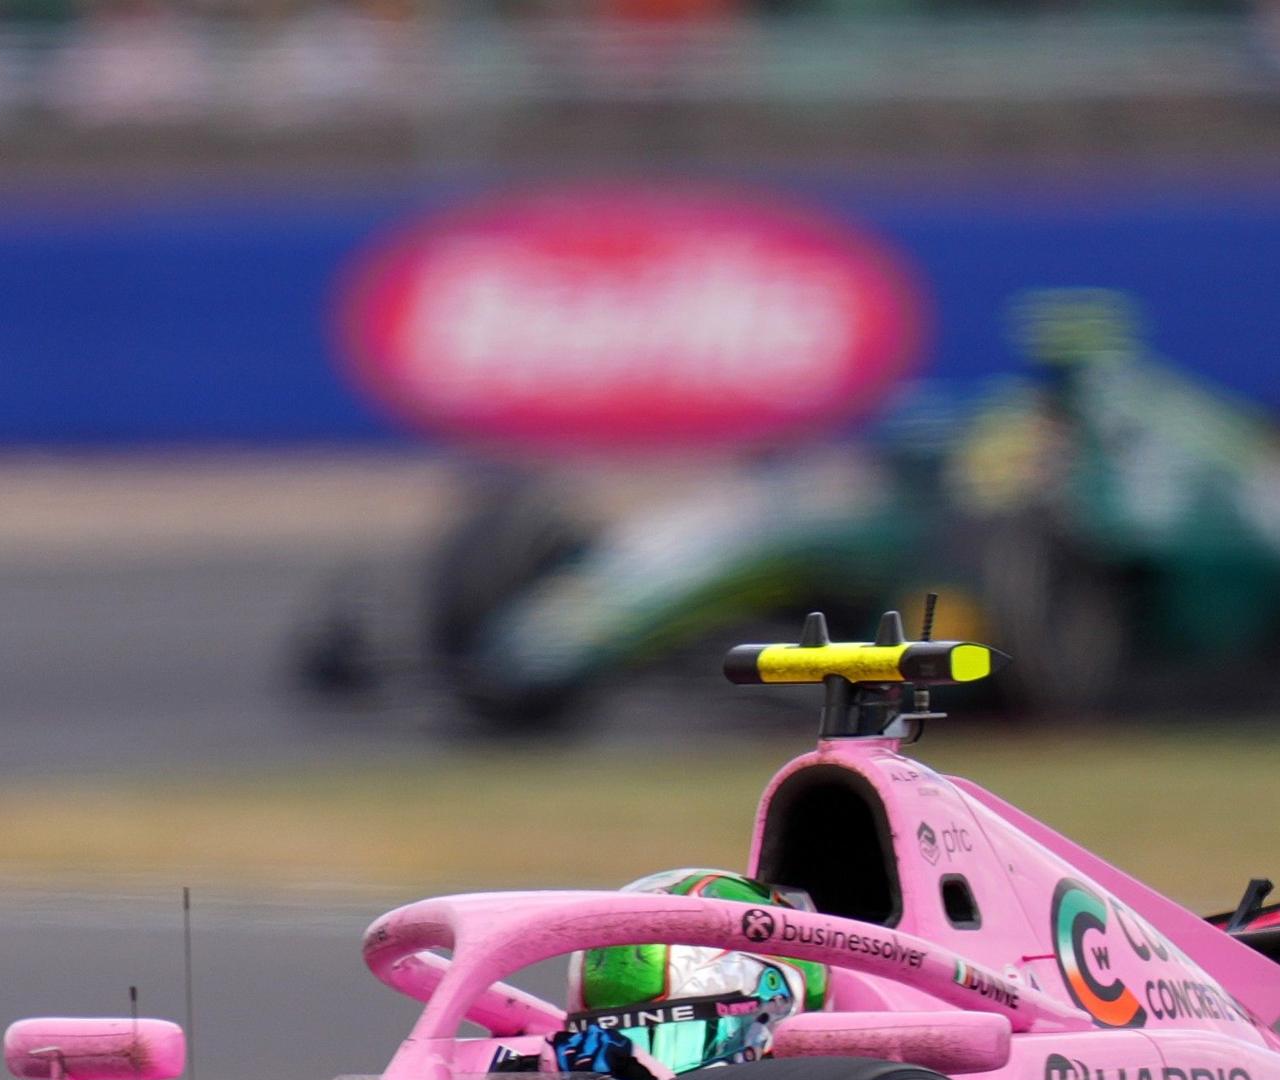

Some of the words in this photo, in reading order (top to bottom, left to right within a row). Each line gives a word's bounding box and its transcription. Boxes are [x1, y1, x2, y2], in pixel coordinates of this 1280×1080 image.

[942, 822, 973, 862] ptc
[780, 914, 927, 969] businessolver
[968, 966, 1021, 1010] DUNNE
